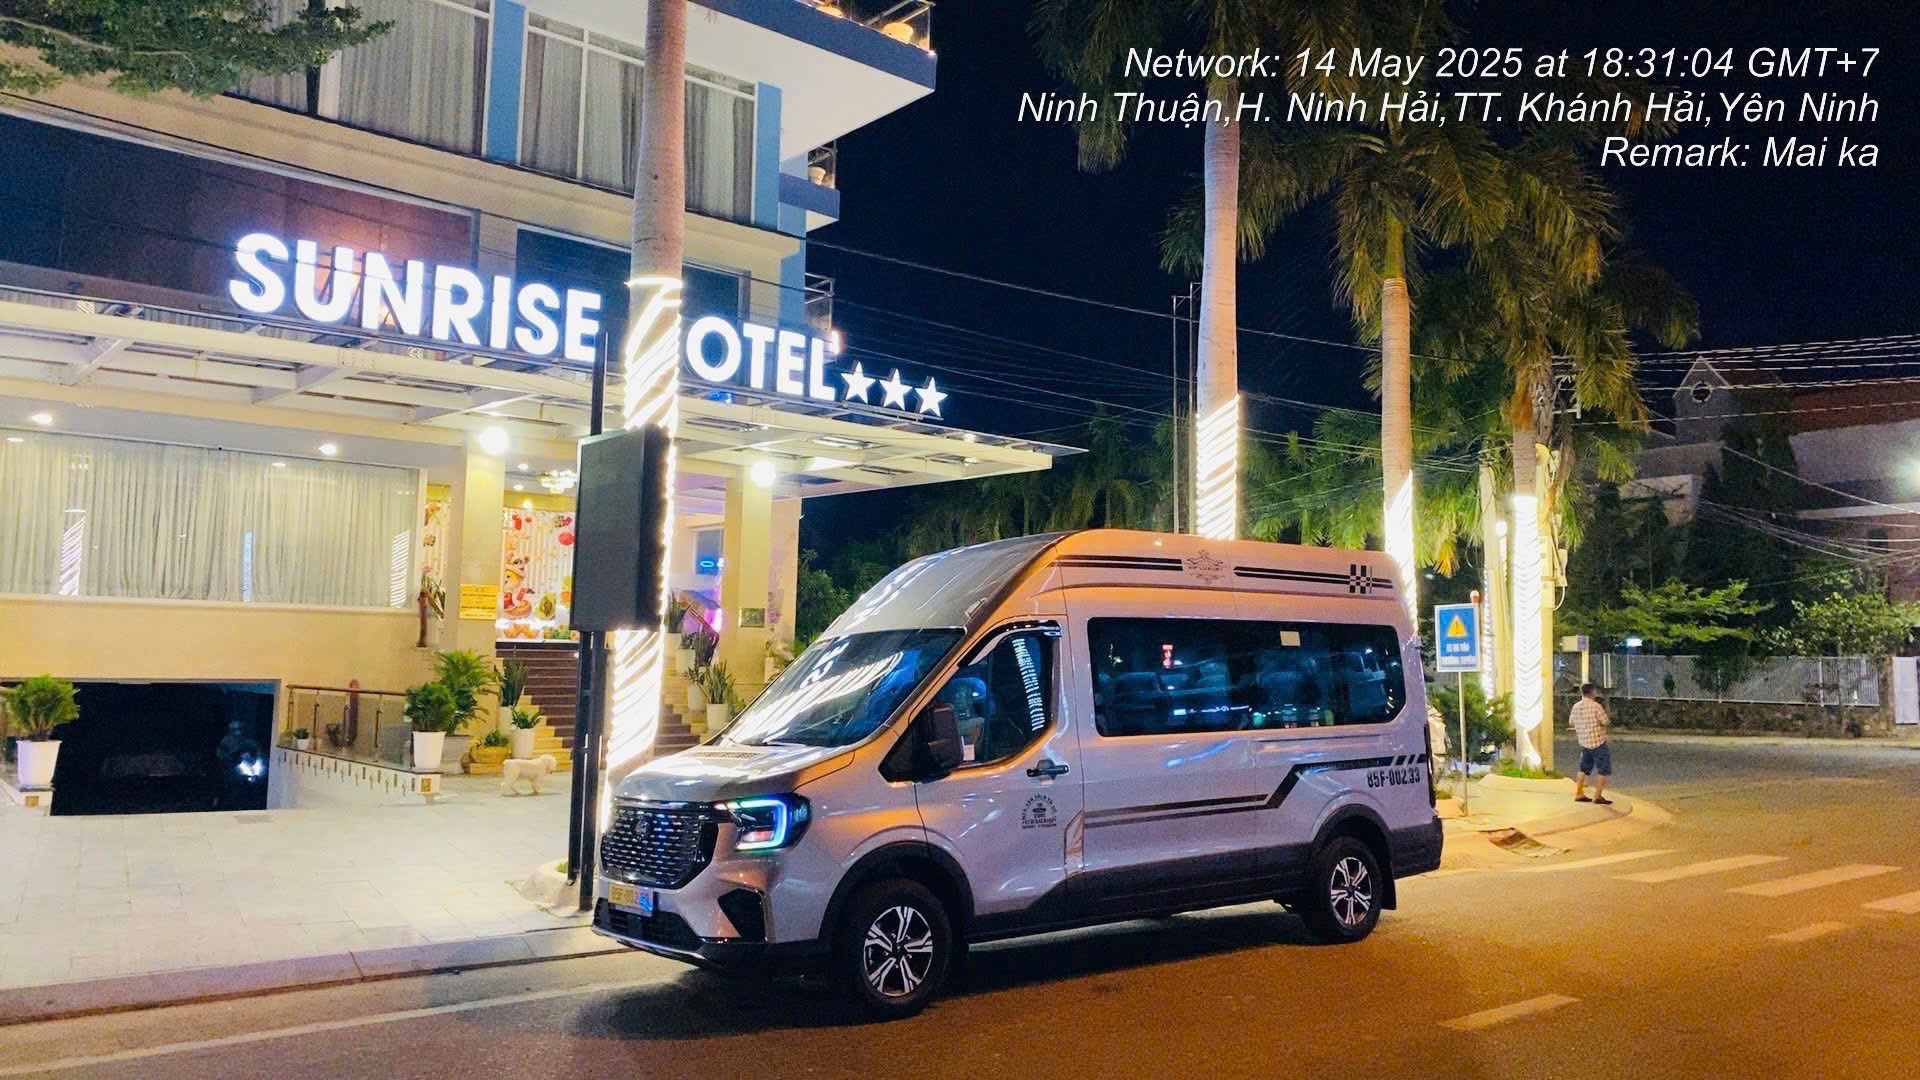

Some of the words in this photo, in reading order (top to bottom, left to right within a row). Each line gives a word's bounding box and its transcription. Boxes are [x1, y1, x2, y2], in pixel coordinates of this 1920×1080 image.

[229, 232, 601, 362] SUNRISE
[685, 316, 836, 401] OTEL
[1367, 767, 1421, 788] 85F-002.33
